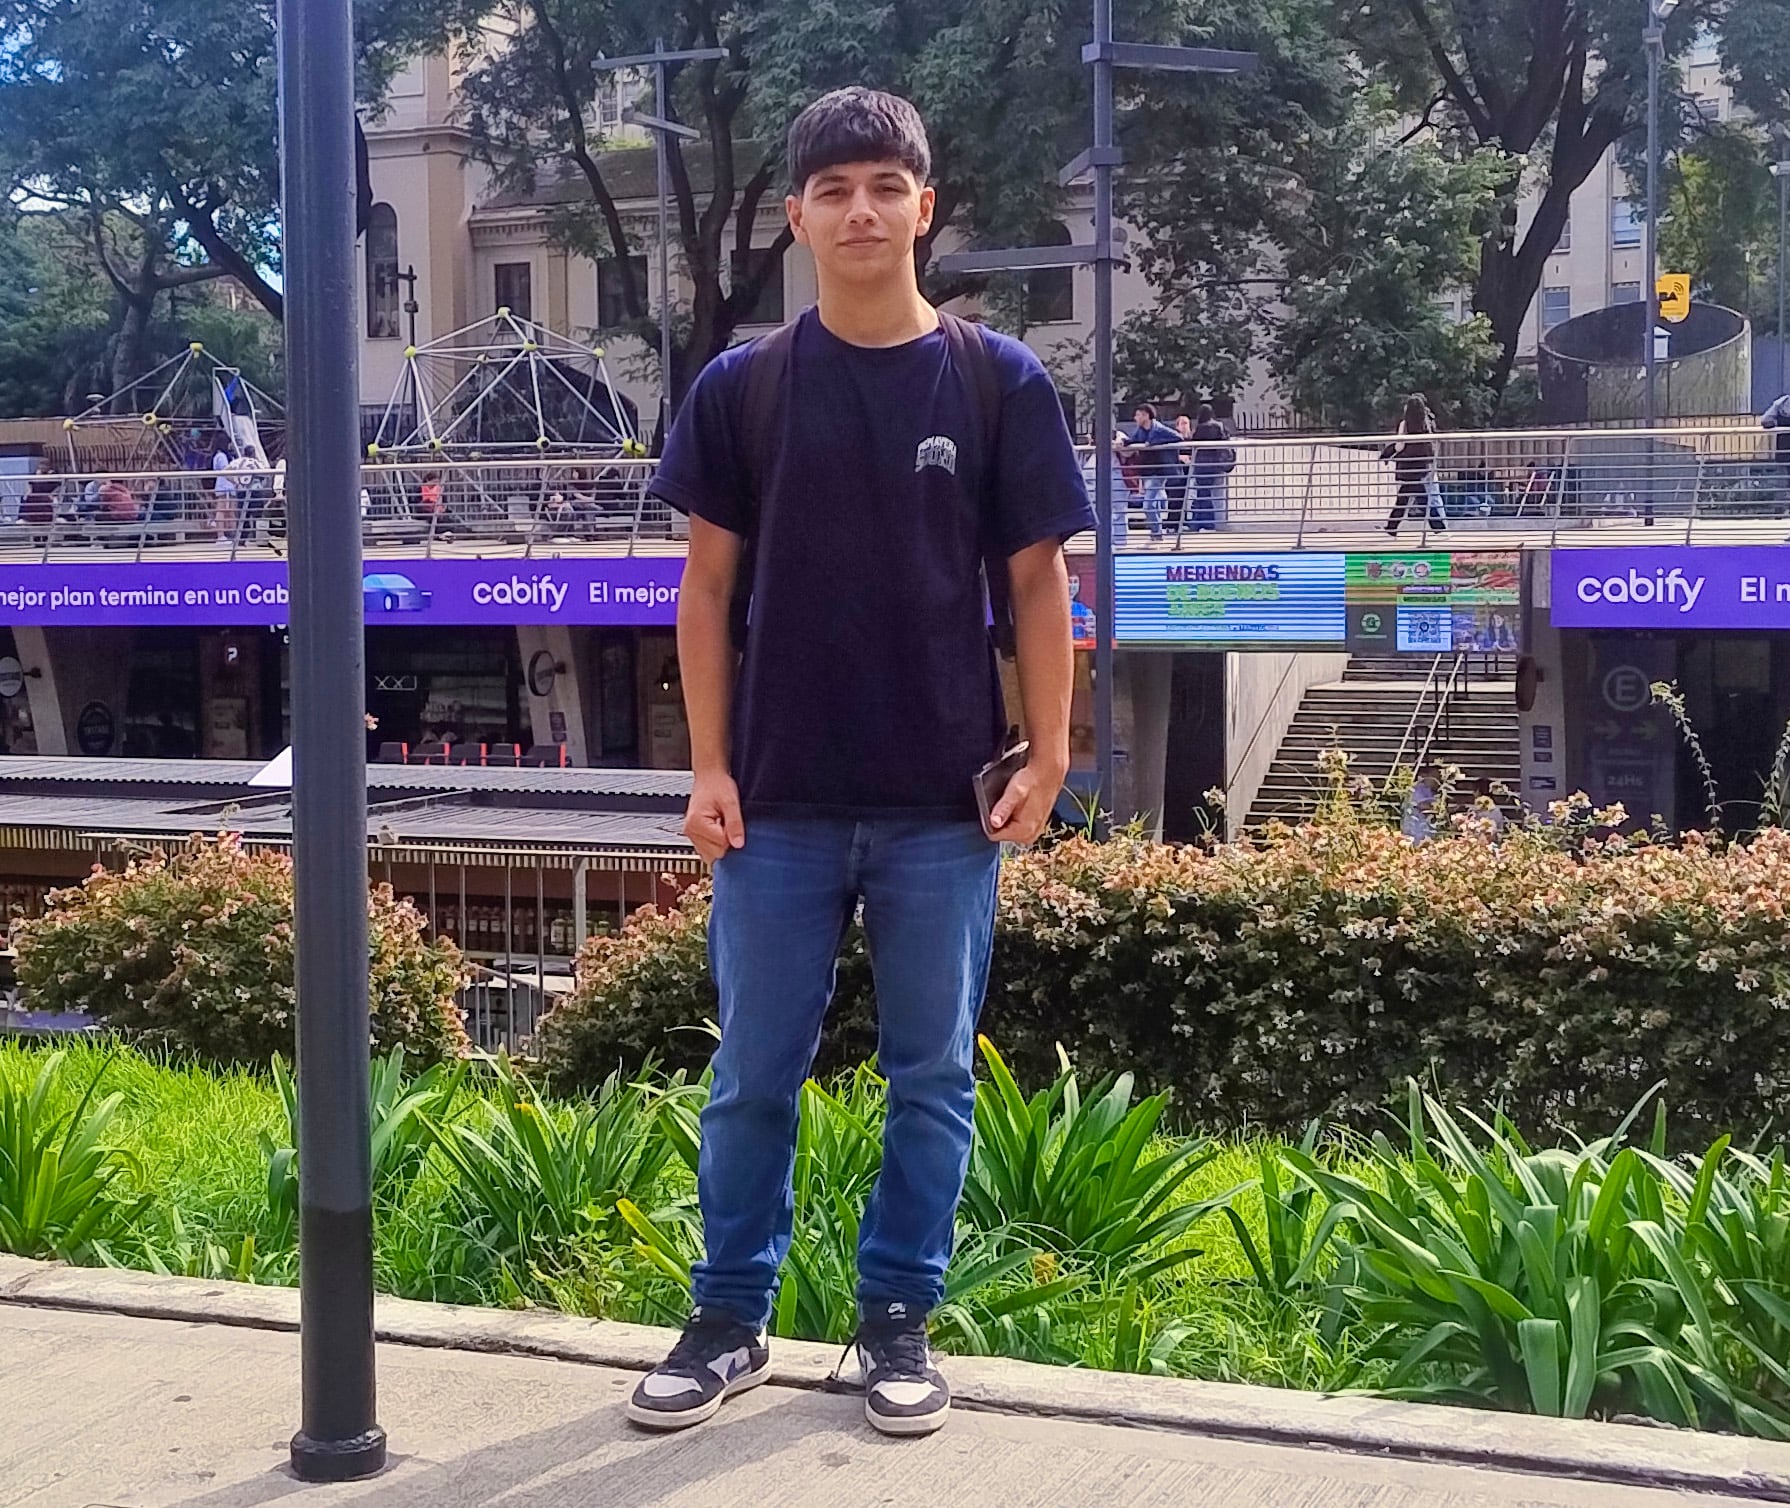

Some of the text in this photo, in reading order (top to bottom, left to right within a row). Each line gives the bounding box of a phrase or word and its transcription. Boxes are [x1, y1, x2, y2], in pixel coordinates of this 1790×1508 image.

[1166, 565, 1280, 581] MERIENDAS
[50, 586, 95, 610] plan
[99, 584, 179, 606] termina
[184, 589, 209, 605] en
[215, 589, 240, 605] un
[473, 575, 569, 612] cabify
[589, 581, 680, 608] El mejor
[1577, 568, 1705, 612] cabify
[1741, 577, 1766, 603] El
[1615, 675, 1637, 701] E
